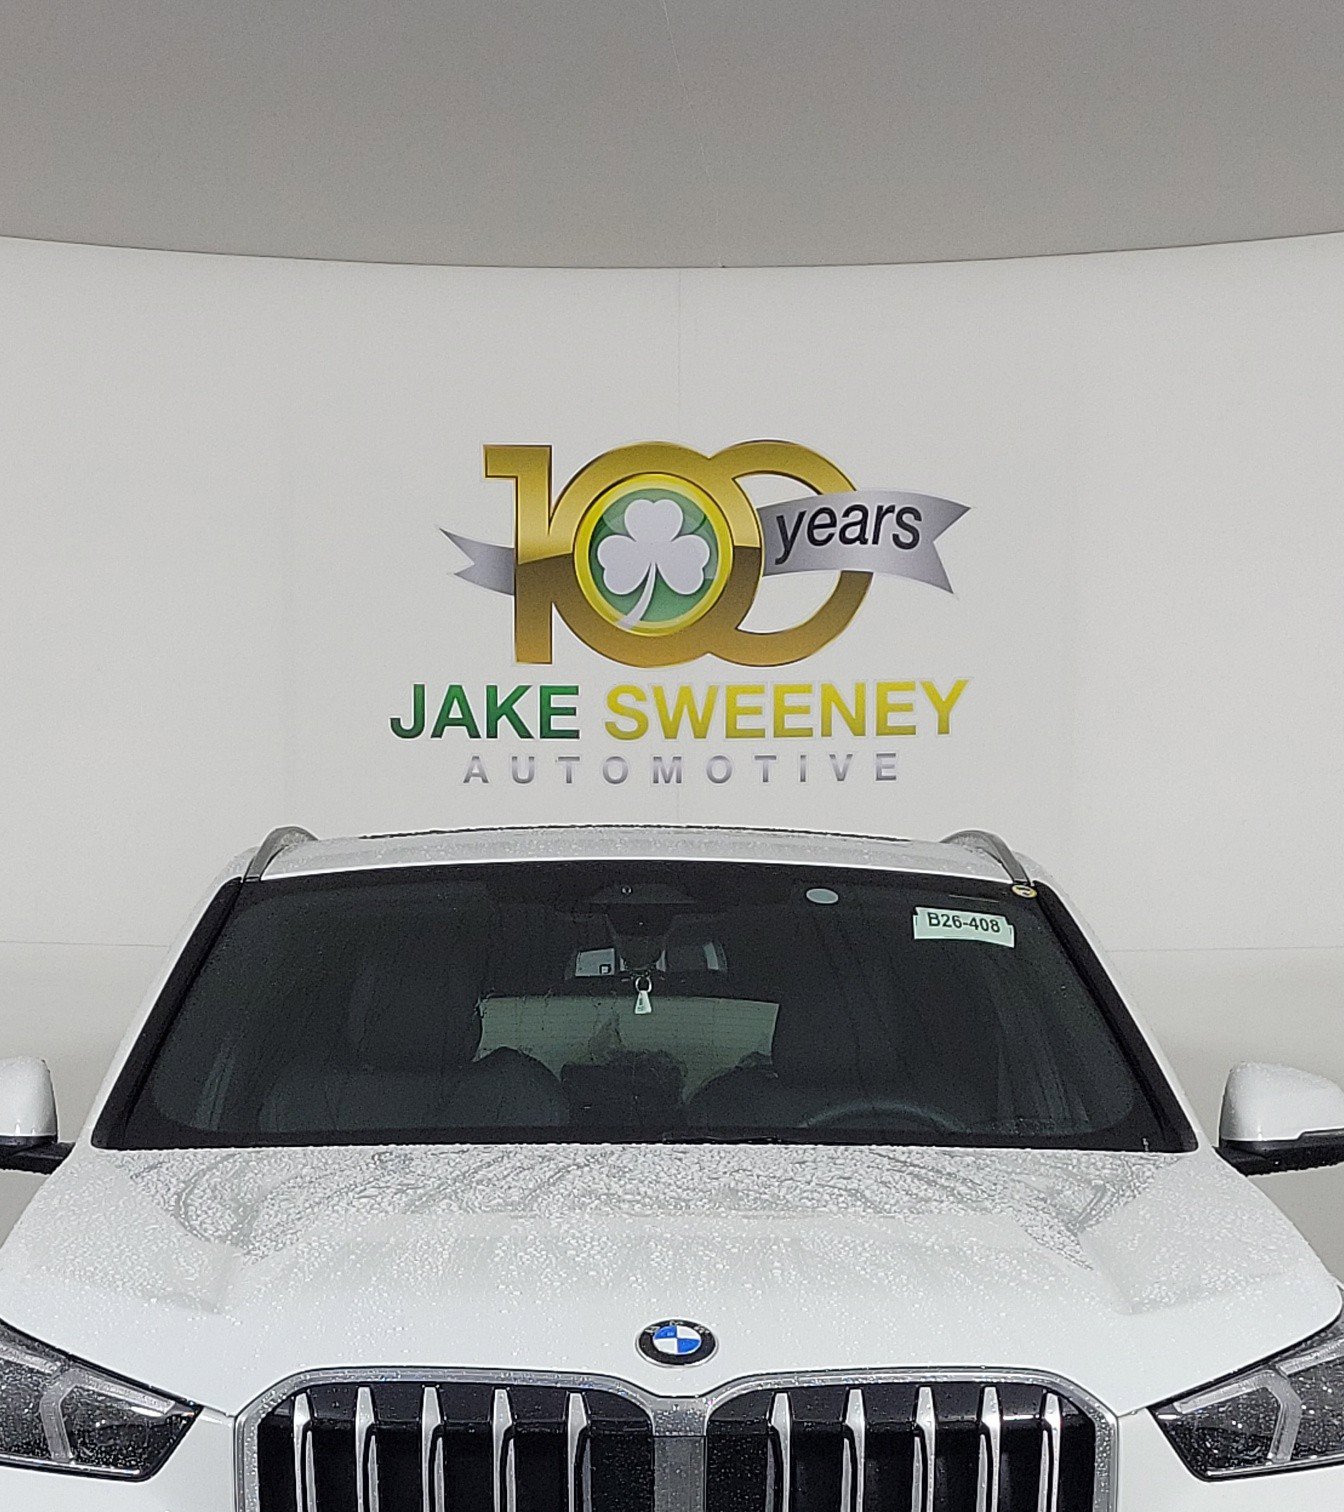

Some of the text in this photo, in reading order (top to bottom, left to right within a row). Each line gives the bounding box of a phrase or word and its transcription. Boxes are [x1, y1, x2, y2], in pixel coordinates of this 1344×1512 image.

[483, 439, 923, 668] 100 years
[390, 679, 970, 740] JAKE SWEENEY
[463, 752, 897, 785] AUTOMOTIVE
[927, 912, 1000, 933] B26-408
